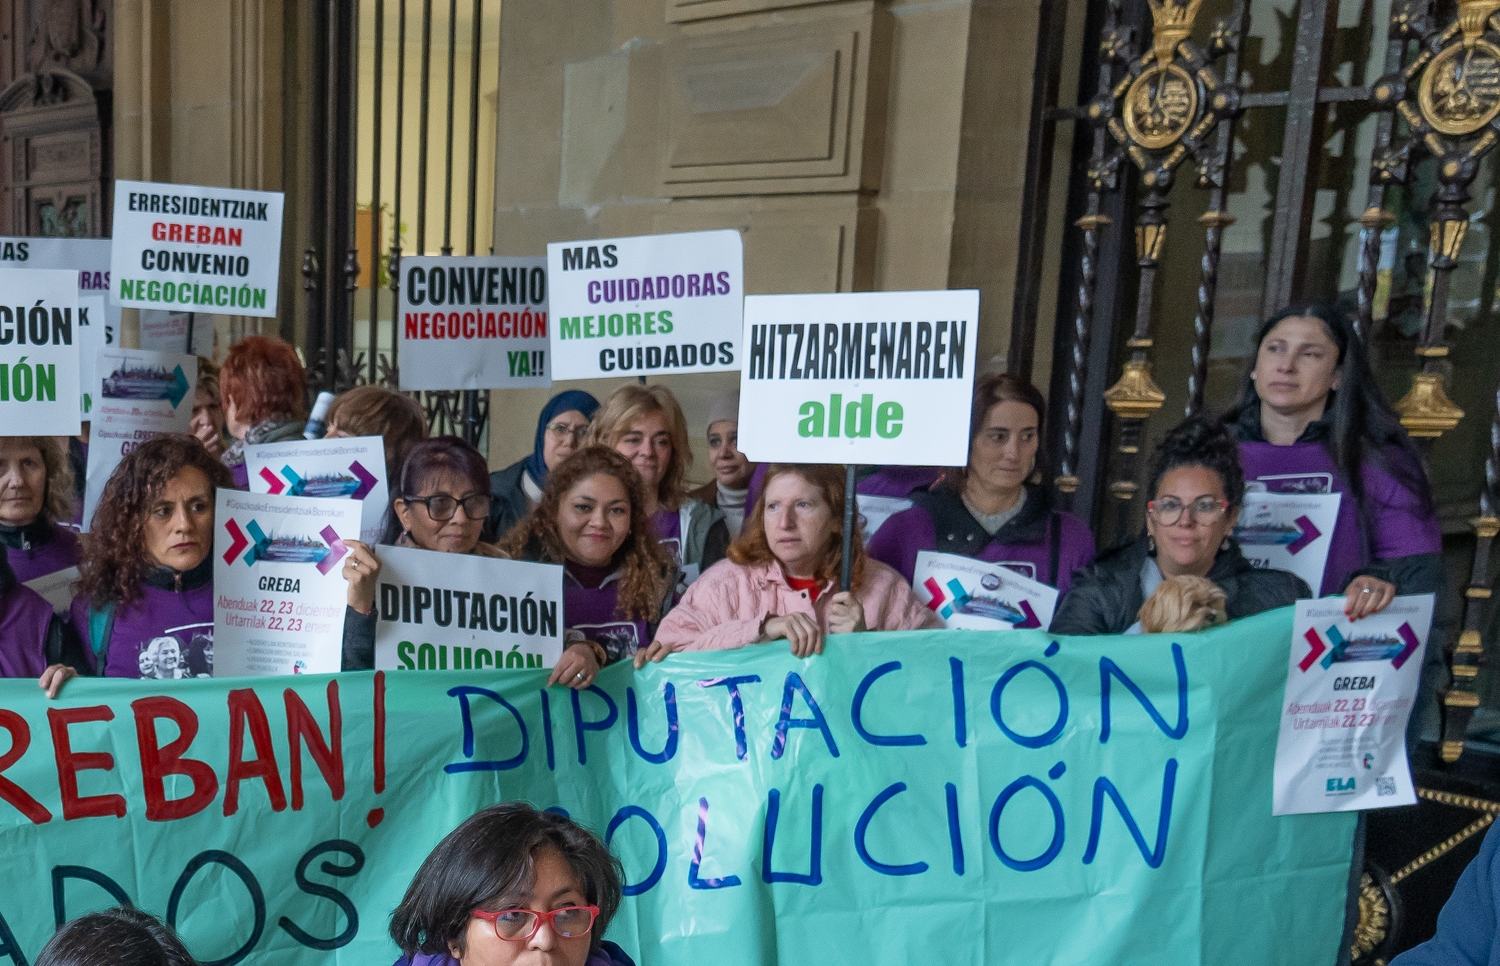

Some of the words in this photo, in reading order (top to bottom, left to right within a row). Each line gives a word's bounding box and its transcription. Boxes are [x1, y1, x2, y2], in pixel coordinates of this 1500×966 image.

[128, 192, 268, 222] ERRESIDENTZIAK
[151, 222, 243, 247] GREBAN
[141, 249, 249, 278] CONVENIO
[561, 244, 618, 271] MAS
[120, 279, 267, 310] NEGOCIACIÓN
[407, 265, 545, 306] CONVENIO
[587, 271, 731, 304] CUIDADORAS
[405, 307, 547, 340] NEGOCIACIÓN
[559, 310, 674, 340] MEJORES
[507, 350, 544, 377] YA!!
[599, 341, 734, 372] CUIDADOS
[748, 320, 967, 380] HITZARMENAREN
[797, 393, 904, 440] alde
[258, 575, 300, 593] GREBA
[217, 595, 258, 612] Abenduak
[260, 599, 276, 614] 22,
[278, 601, 294, 614] 23
[380, 583, 558, 638] DIPUTACIÓN
[225, 612, 266, 628] Urtarrilak
[267, 617, 284, 632] 22,
[287, 618, 303, 631] 23
[1333, 676, 1376, 691] GREBA
[444, 641, 1188, 774] DIPUTACIÓN
[1351, 698, 1367, 712] 23
[1325, 777, 1357, 792] ELA
[543, 759, 1178, 896] OLUCIÓN
